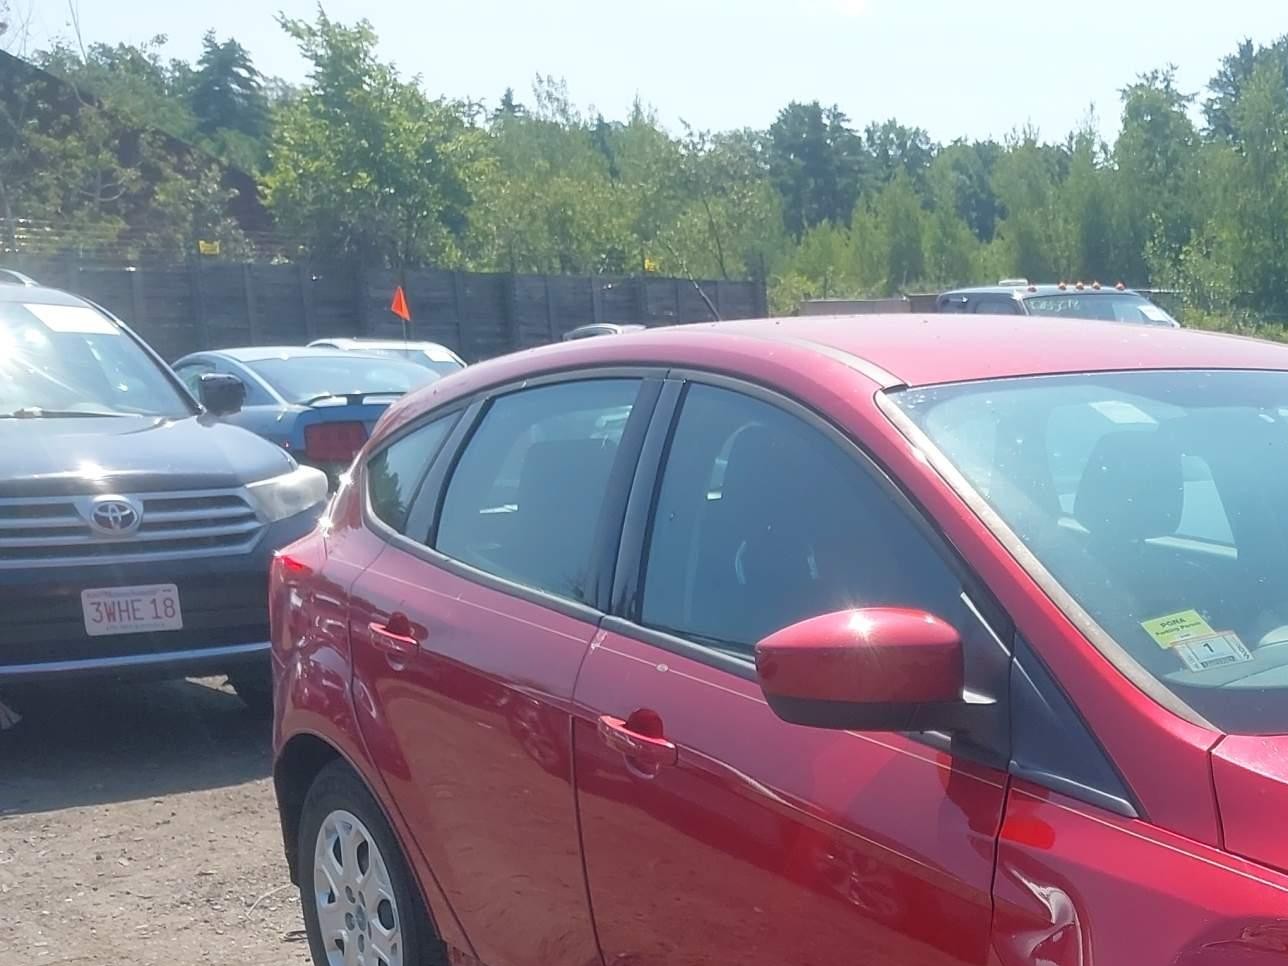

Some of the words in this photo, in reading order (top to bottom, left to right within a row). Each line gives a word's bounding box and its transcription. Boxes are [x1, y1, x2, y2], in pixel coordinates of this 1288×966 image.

[89, 598, 145, 624] 3WHE
[149, 597, 176, 620] 18
[1203, 643, 1215, 653] 1
